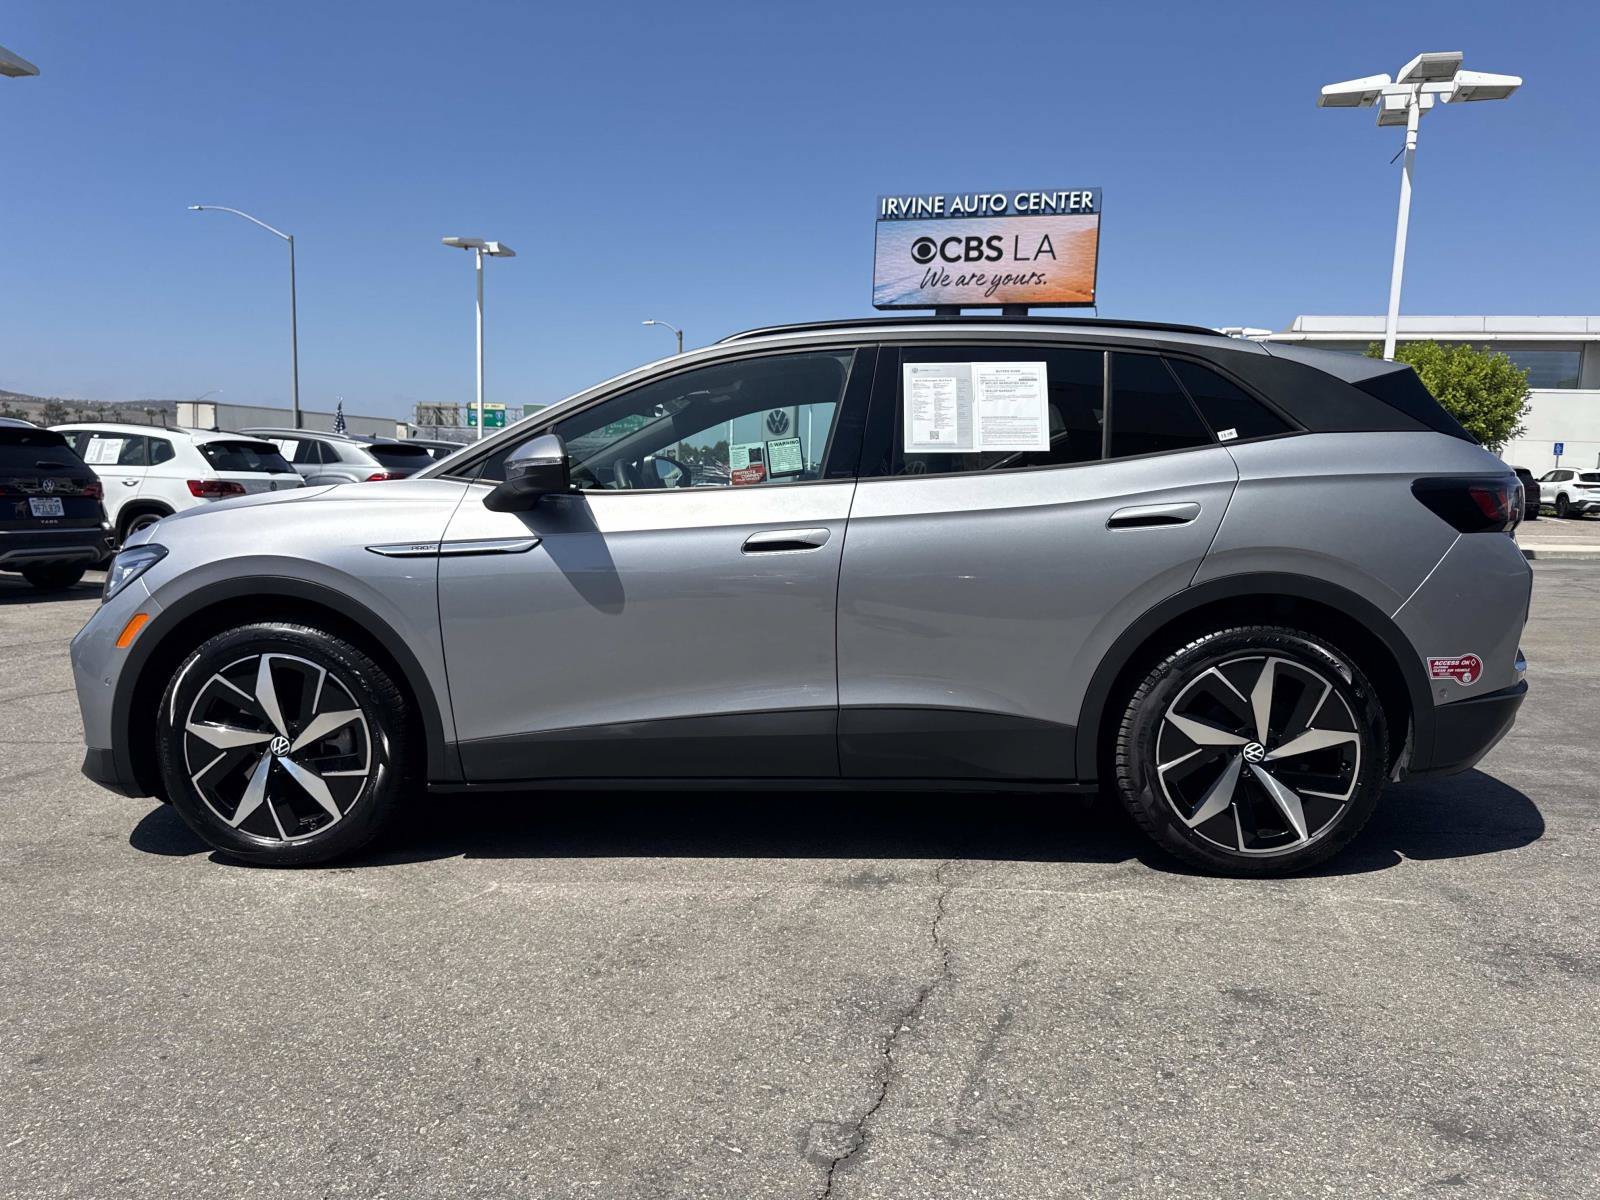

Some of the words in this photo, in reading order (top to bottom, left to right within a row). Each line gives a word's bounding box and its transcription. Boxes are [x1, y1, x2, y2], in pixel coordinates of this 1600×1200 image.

[882, 196, 945, 215] IRVINE
[949, 193, 1008, 212] AUTO
[1013, 191, 1094, 211] CENTER
[939, 235, 1004, 263] CBS
[1013, 234, 1057, 261] LA
[919, 266, 950, 289] We
[955, 273, 988, 286] are
[983, 271, 1048, 297] yours.
[773, 439, 799, 447] WARNING
